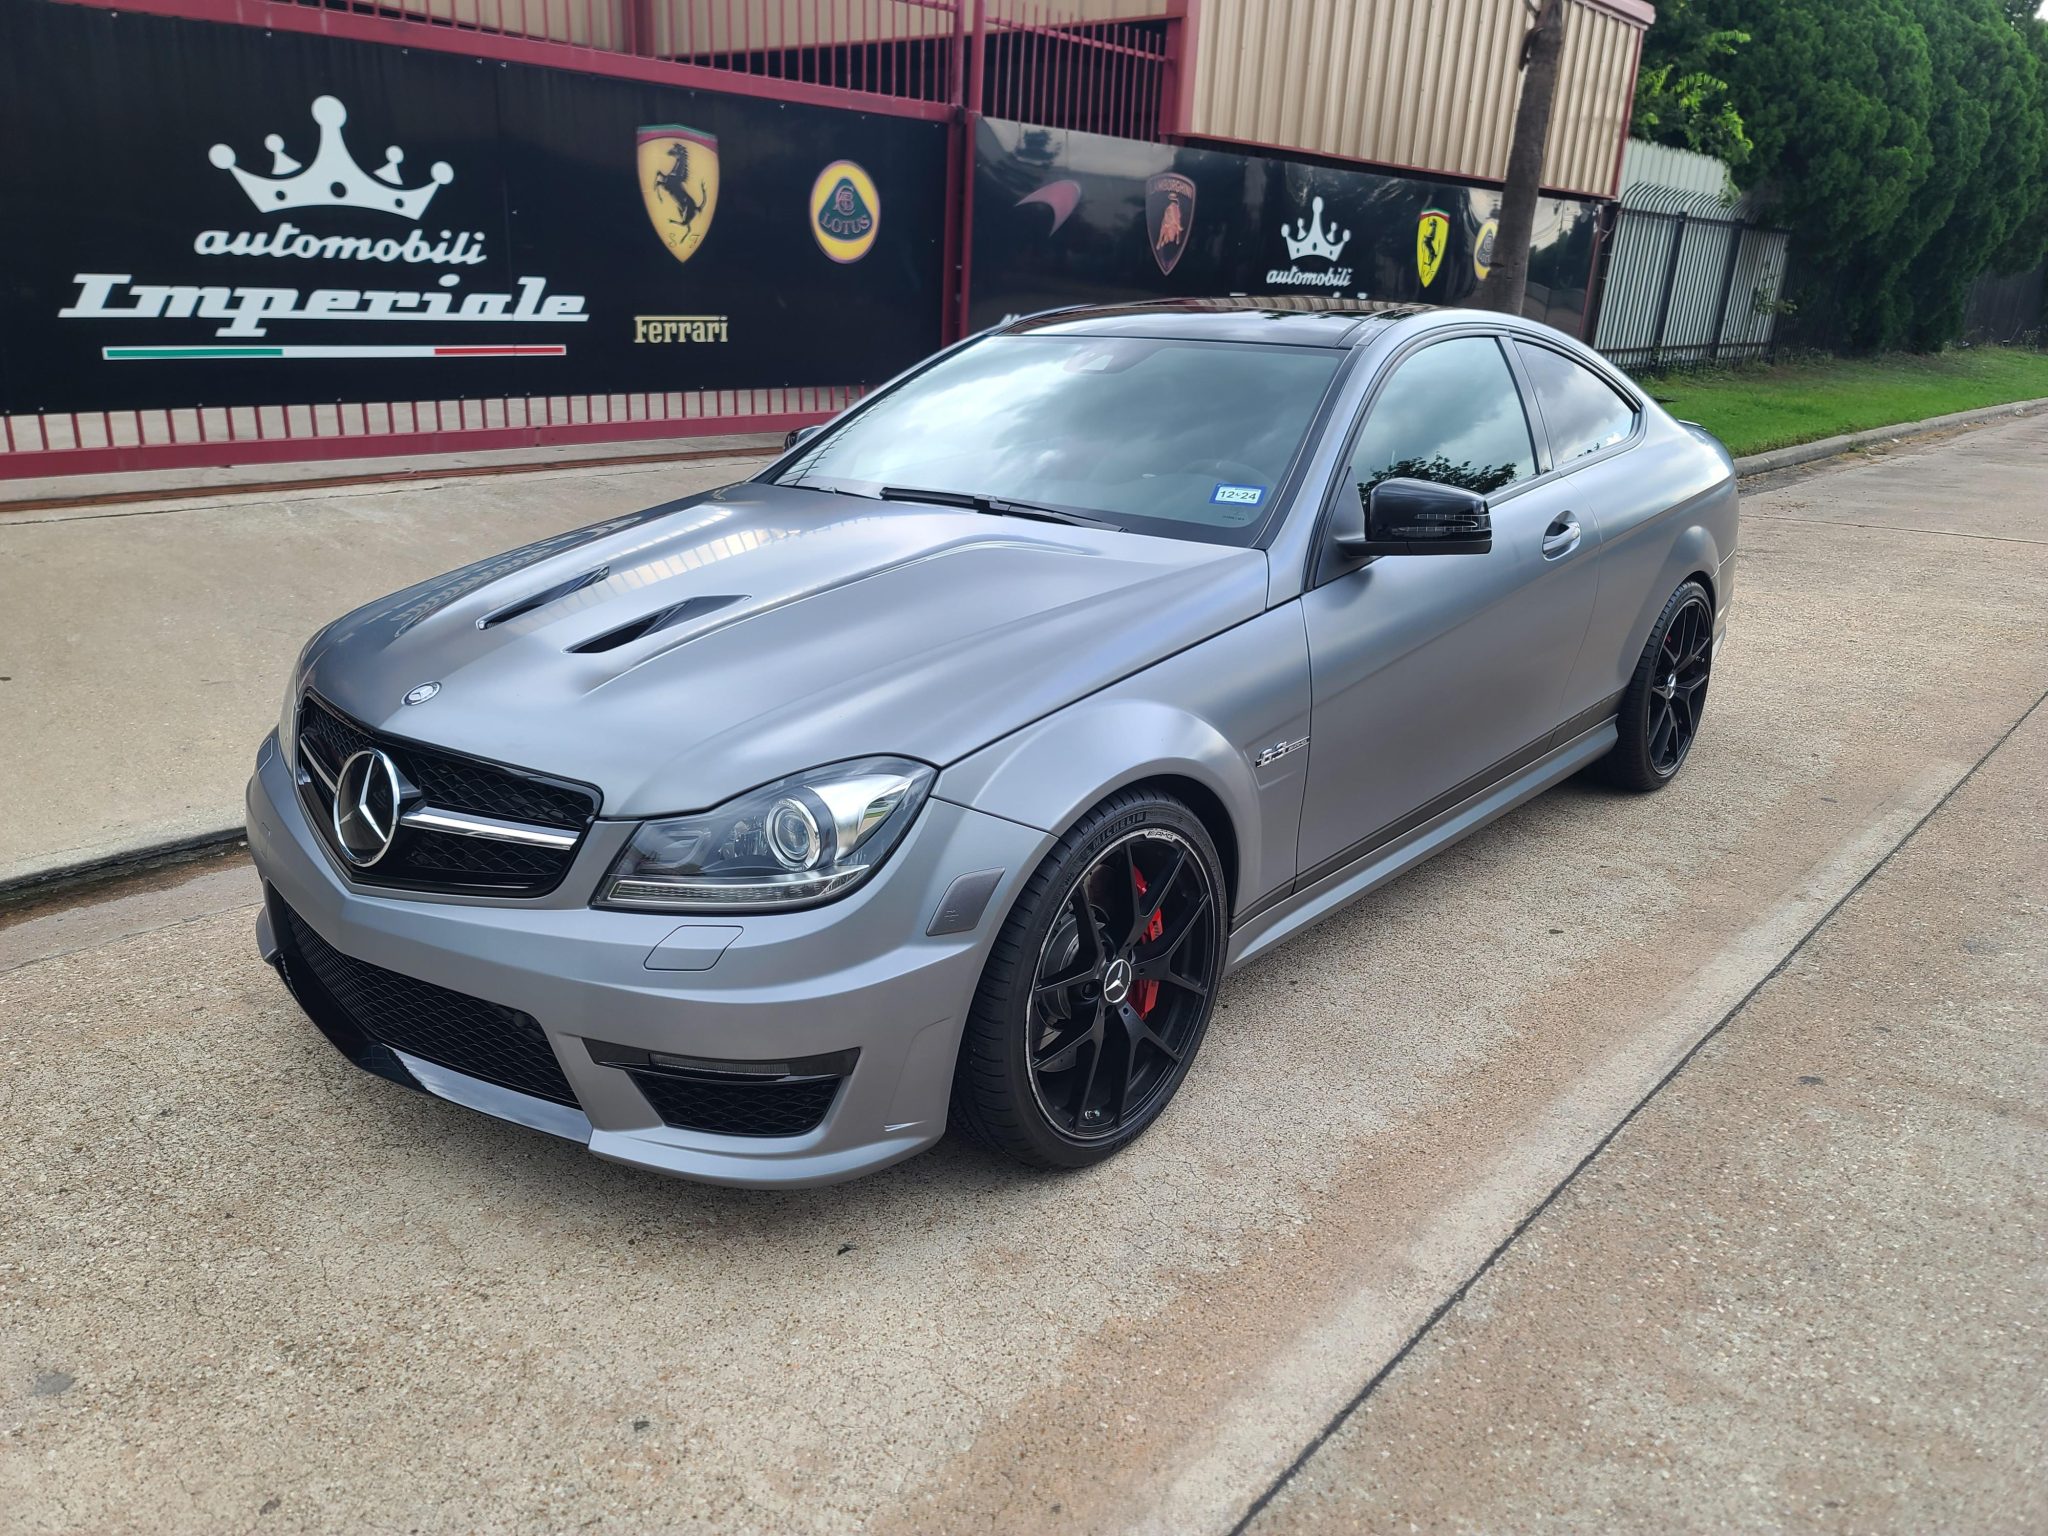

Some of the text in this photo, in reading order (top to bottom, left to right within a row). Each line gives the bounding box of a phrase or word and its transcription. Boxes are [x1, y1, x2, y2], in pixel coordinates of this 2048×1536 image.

[821, 212, 871, 235] LOTUS
[193, 222, 487, 264] automobili
[1265, 265, 1353, 287] automobili
[58, 273, 590, 337] Imperiale
[633, 315, 729, 343] Ferrari
[1093, 812, 1147, 849] MICHELIN
